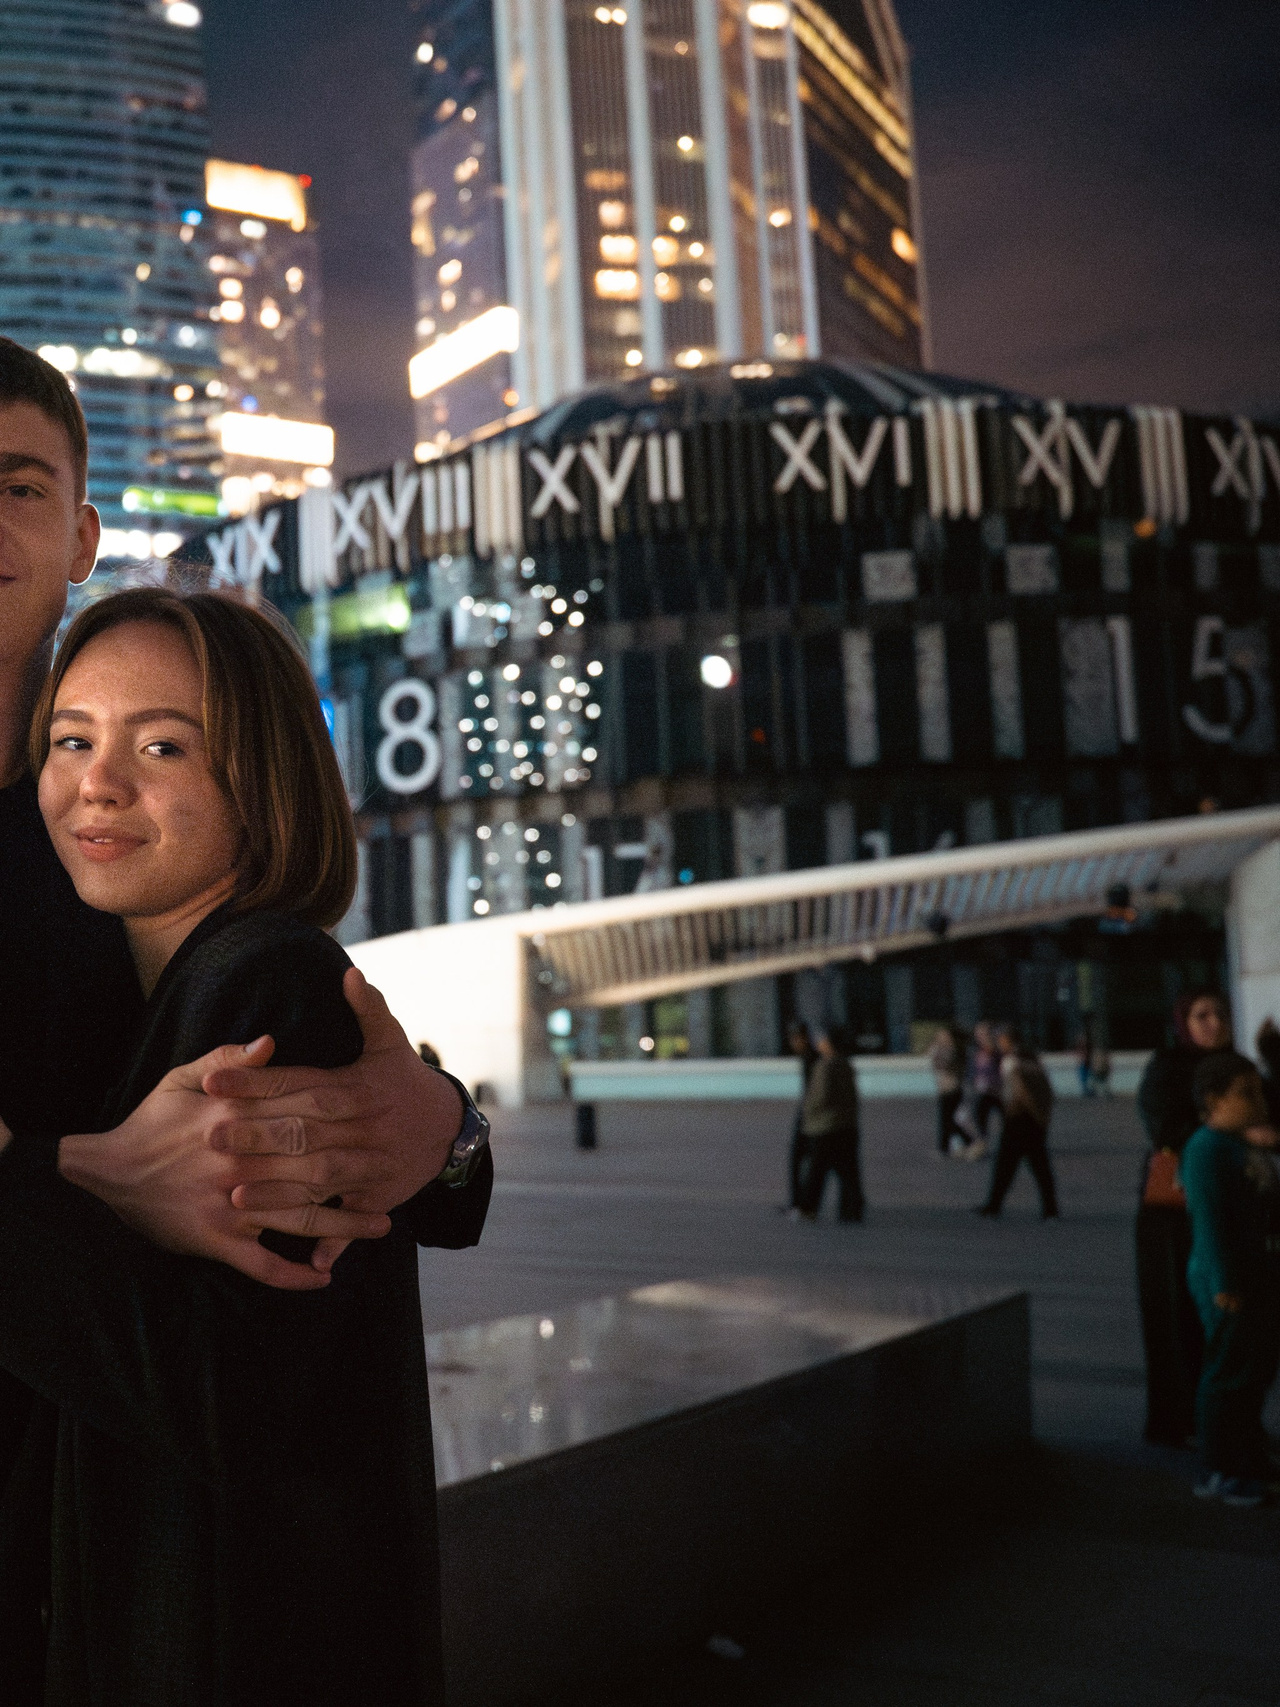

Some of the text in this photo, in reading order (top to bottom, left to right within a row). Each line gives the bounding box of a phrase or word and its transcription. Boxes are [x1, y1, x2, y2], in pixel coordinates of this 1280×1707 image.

[333, 466, 470, 556] XVIII
[527, 431, 684, 520] XVII
[769, 415, 912, 494] XVI
